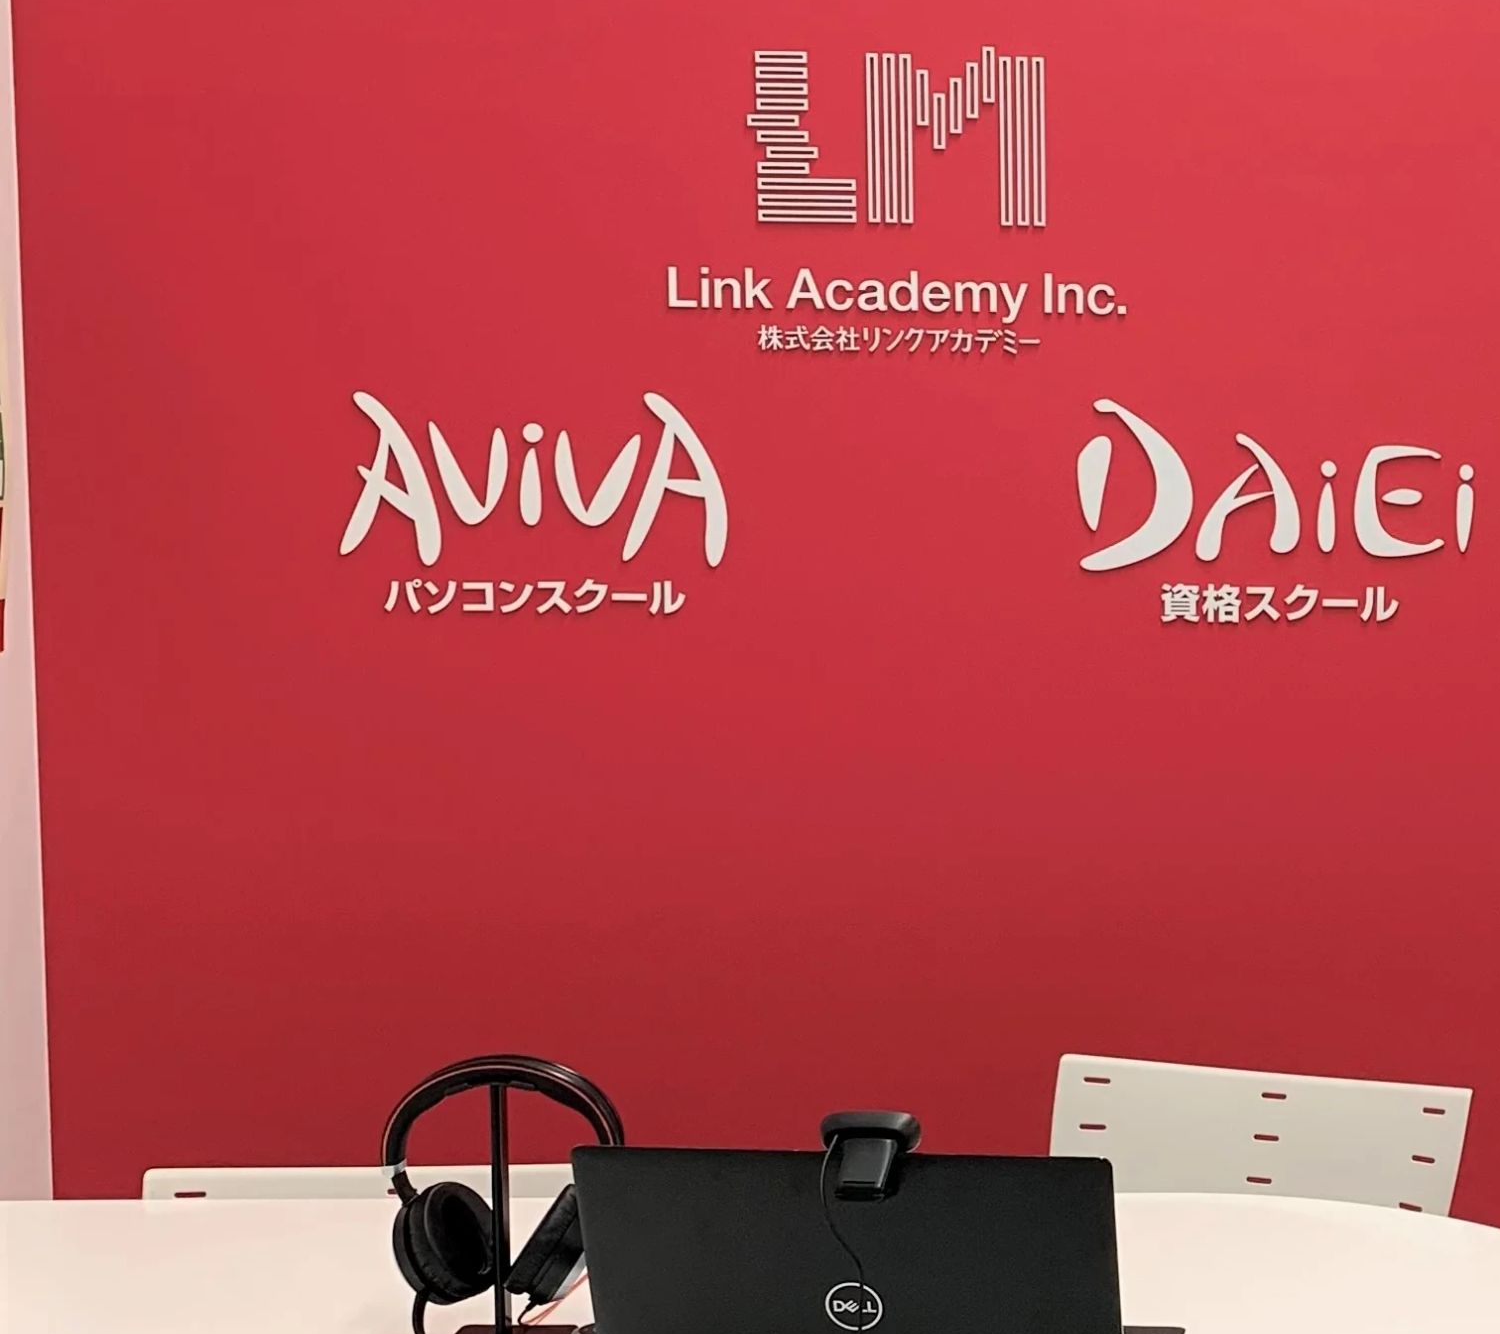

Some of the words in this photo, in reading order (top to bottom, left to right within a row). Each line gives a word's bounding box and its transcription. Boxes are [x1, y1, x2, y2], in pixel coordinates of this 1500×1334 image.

[668, 267, 772, 308] Link
[787, 269, 1027, 323] Academy
[1045, 273, 1127, 315] Inc.
[758, 326, 1040, 353] 株式会社リンクアカデミー
[385, 579, 685, 615] パソコンスクール
[1162, 584, 1398, 623] 資格スクール
